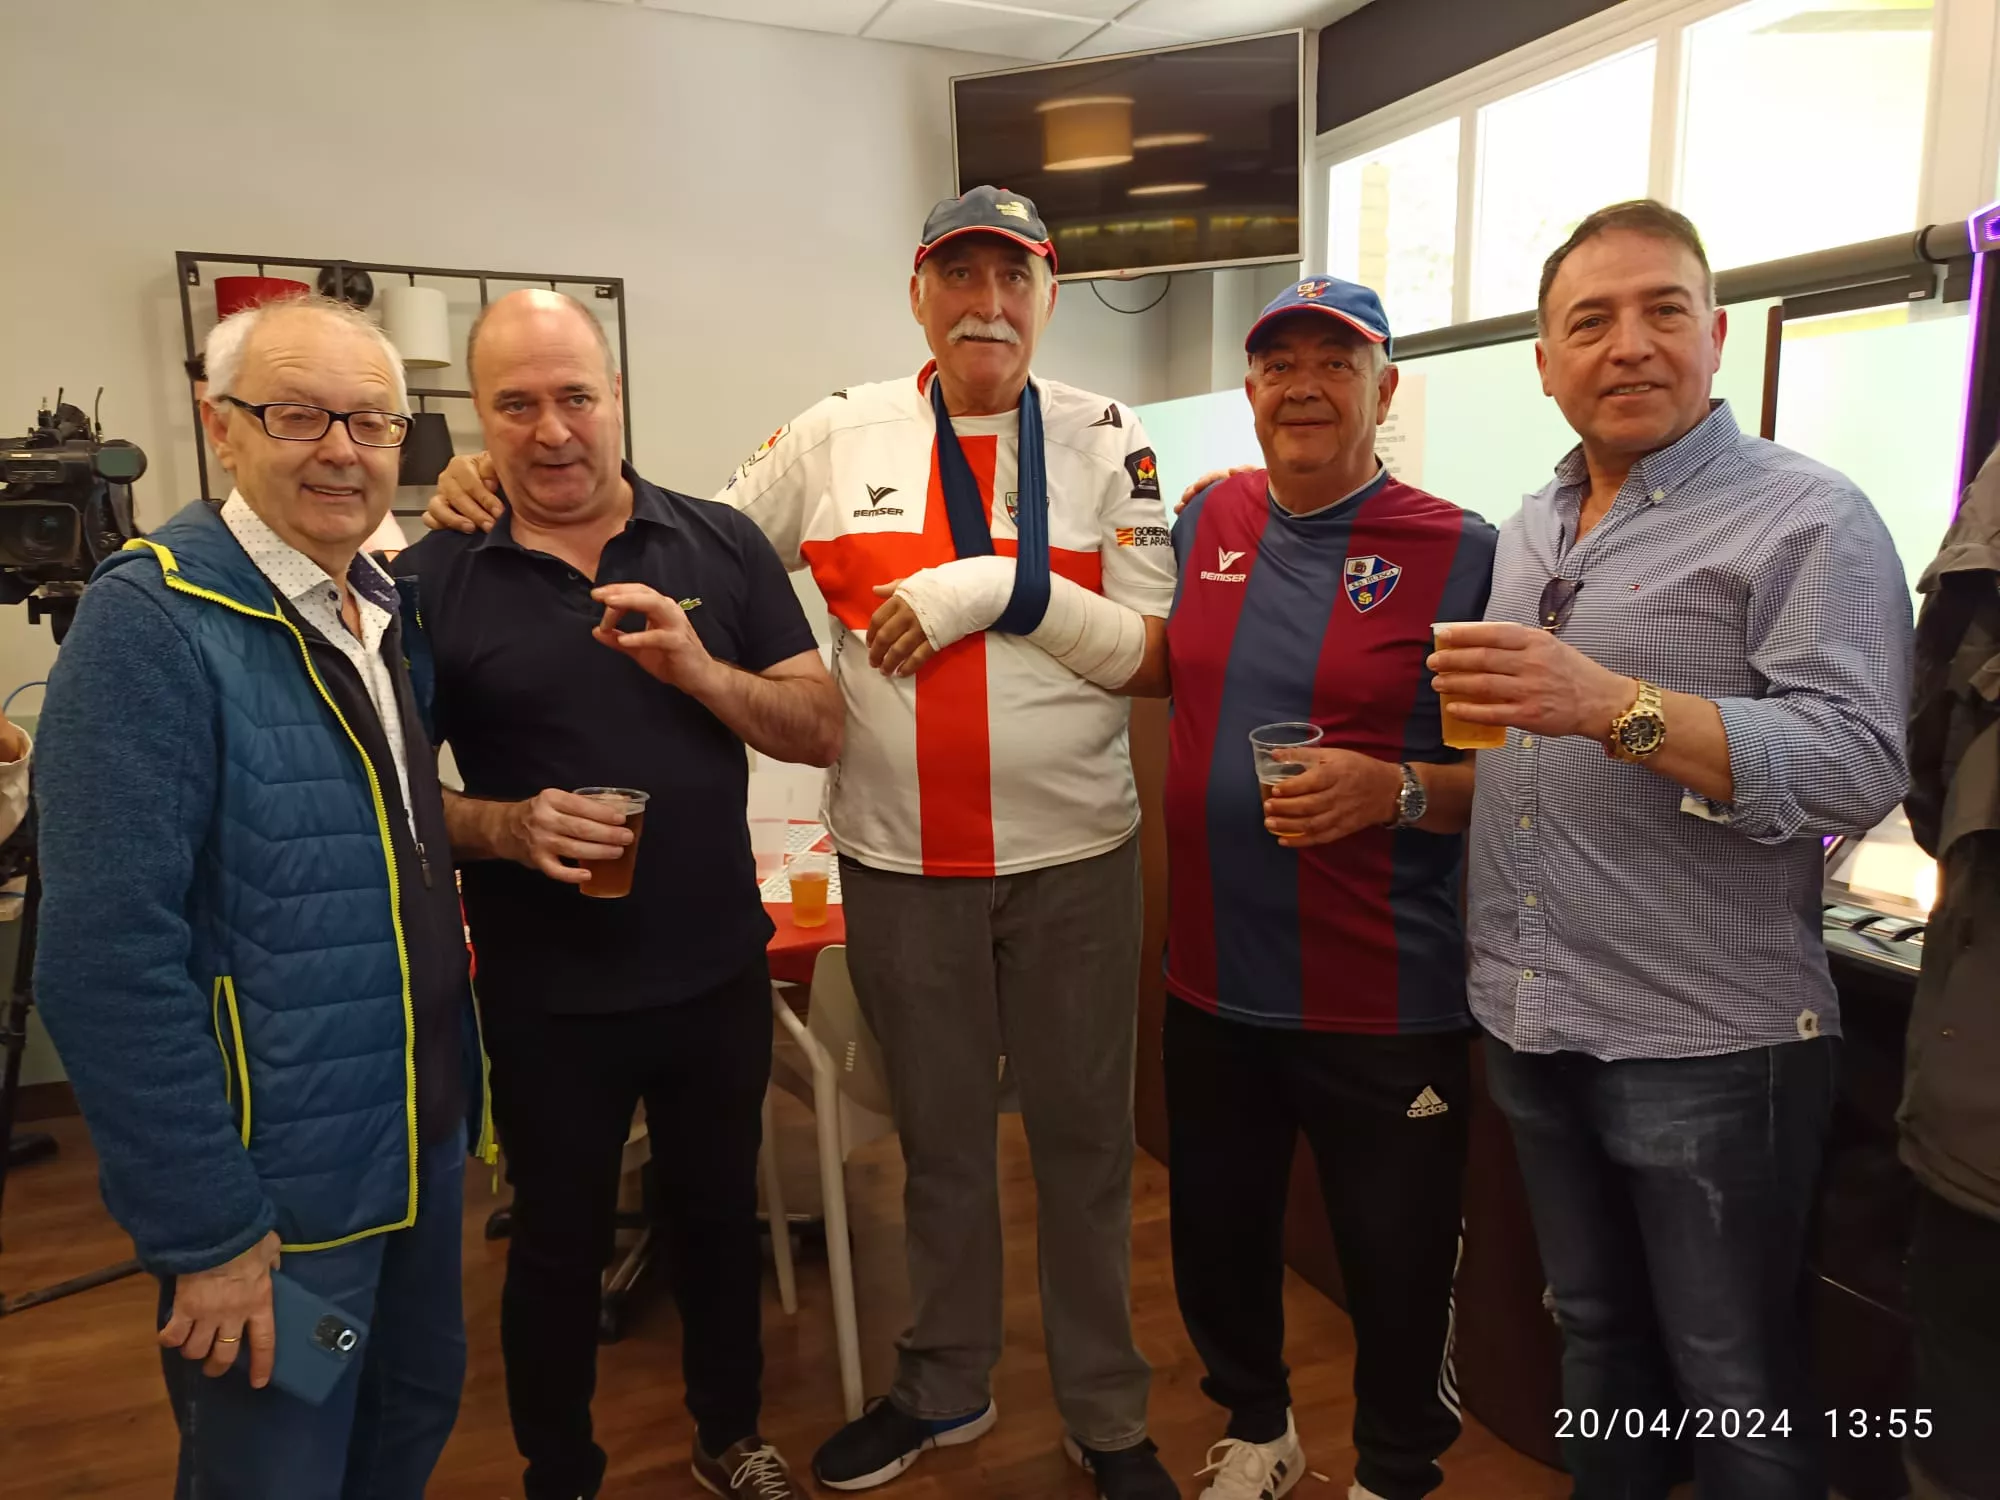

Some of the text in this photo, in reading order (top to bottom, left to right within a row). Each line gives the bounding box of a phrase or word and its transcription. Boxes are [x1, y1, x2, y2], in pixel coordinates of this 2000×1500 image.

[1135, 536, 1174, 547] DE ARAG
[1200, 571, 1247, 582] BEMISER
[1406, 1102, 1449, 1118] adidas
